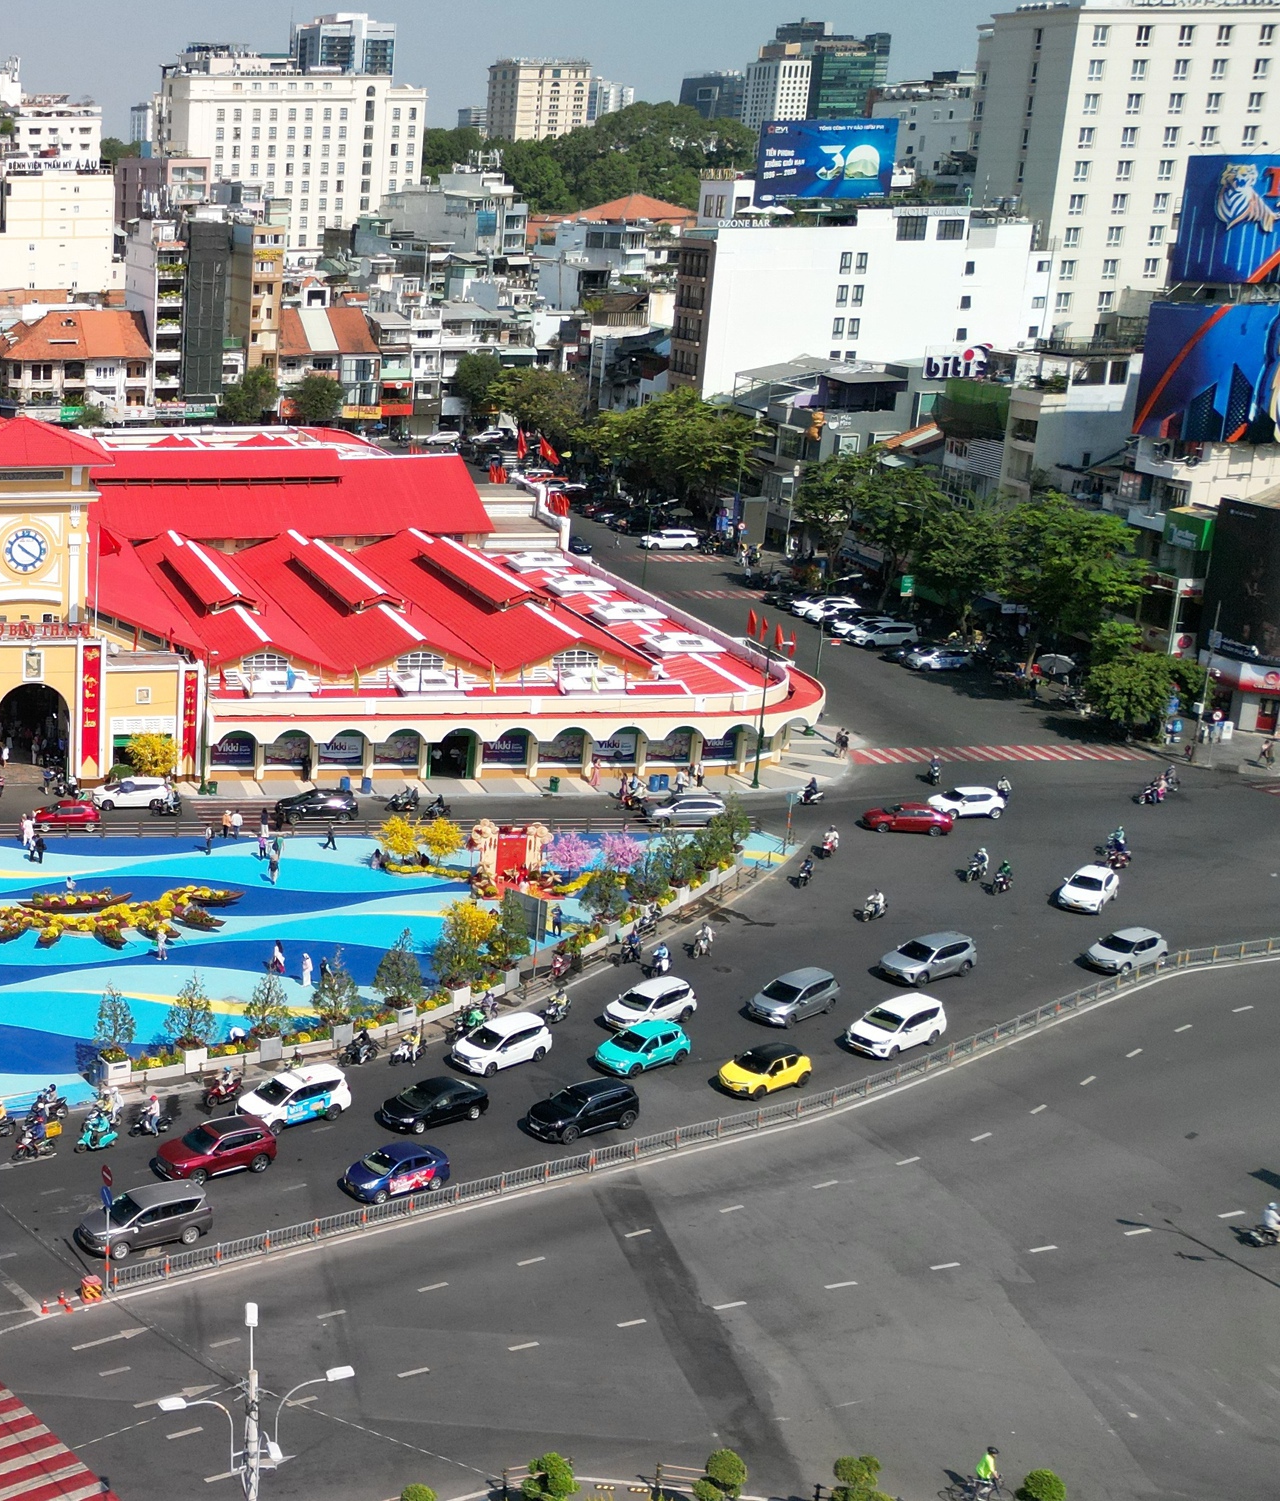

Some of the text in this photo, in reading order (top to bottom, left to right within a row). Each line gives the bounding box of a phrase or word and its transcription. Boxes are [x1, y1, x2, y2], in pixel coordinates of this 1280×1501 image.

[816, 144, 880, 180] 30
[718, 219, 771, 228] OZONE BAR
[216, 738, 239, 752] Vikki
[324, 739, 347, 751] Vikki
[488, 741, 511, 750] Vikki
[597, 740, 620, 749] Vikki
[705, 739, 724, 749] Vikki
